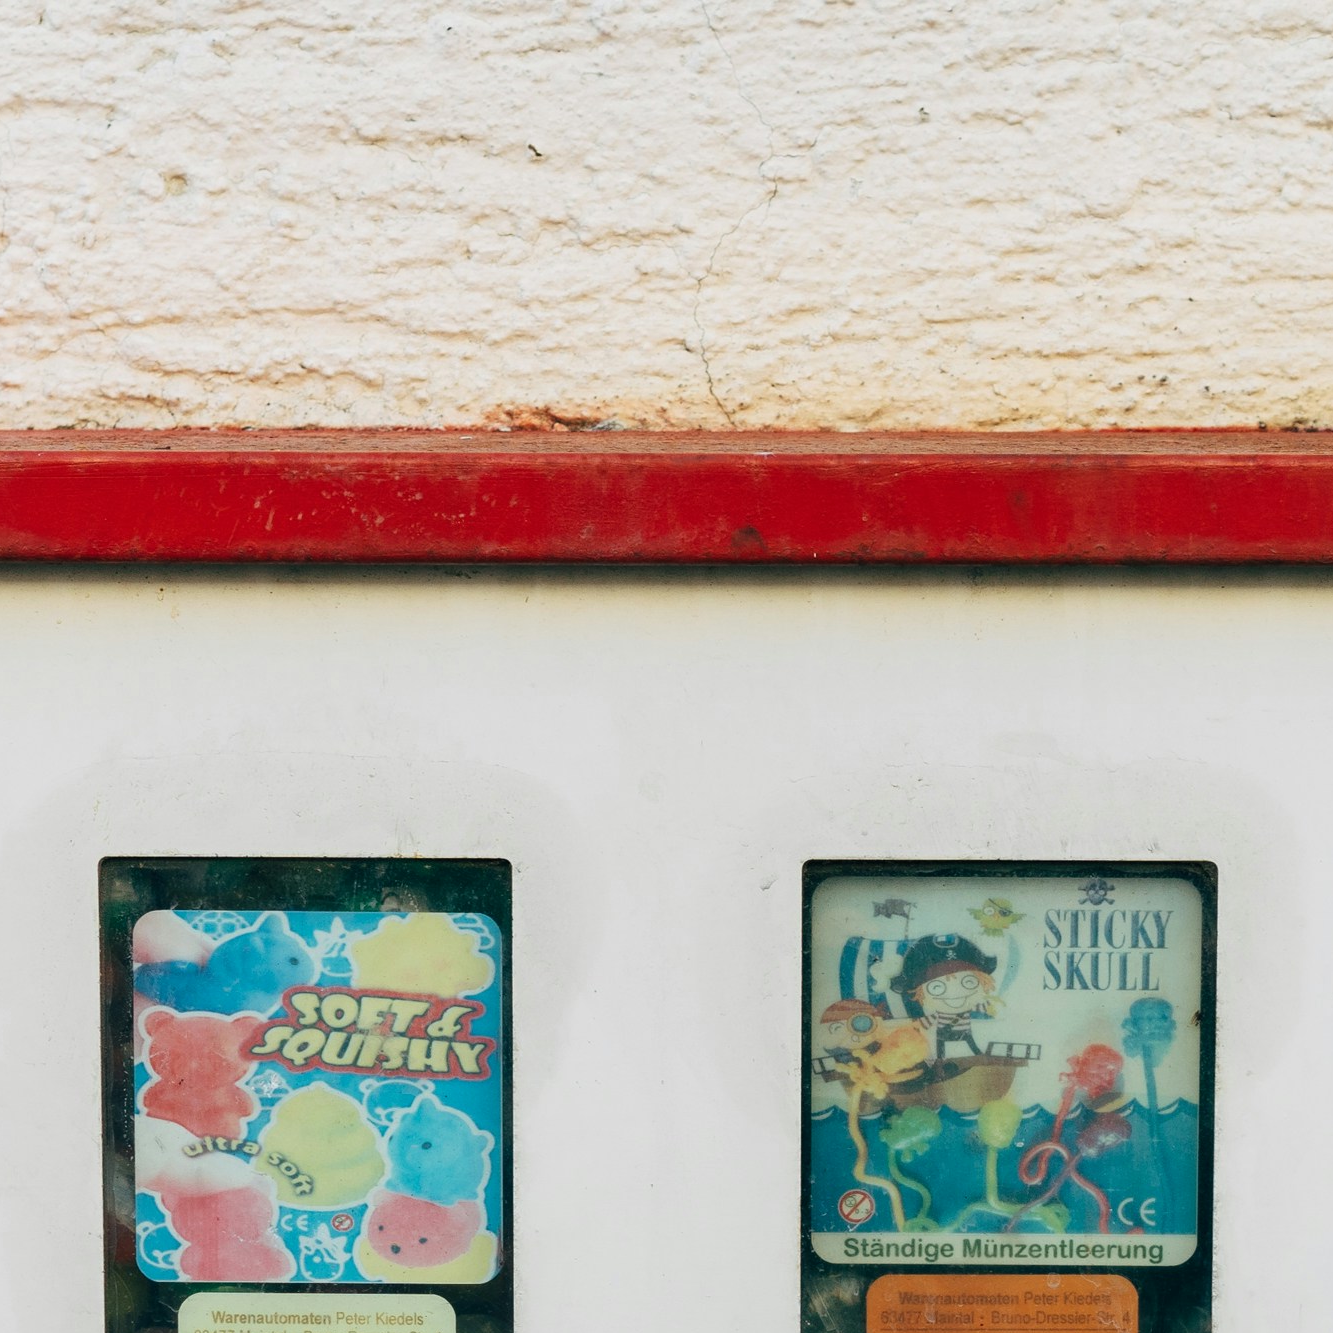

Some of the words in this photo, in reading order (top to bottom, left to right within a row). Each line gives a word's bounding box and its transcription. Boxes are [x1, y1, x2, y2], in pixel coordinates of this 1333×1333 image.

[1043, 908, 1174, 950] STICKY
[1042, 951, 1161, 992] SKULL
[291, 992, 430, 1036] SOFT
[426, 1006, 473, 1038] &
[251, 1027, 487, 1075] SQUISHY
[183, 1136, 261, 1158] ultra
[269, 1152, 315, 1196] soft
[1117, 1197, 1157, 1226] CE
[843, 1238, 954, 1262] Ständige
[963, 1239, 1164, 1264] Münzentleerung
[1024, 1291, 1059, 1306] Peter
[212, 1311, 332, 1325] Warenautomaten
[336, 1311, 372, 1325] Peter
[376, 1312, 424, 1326] Kiedels
